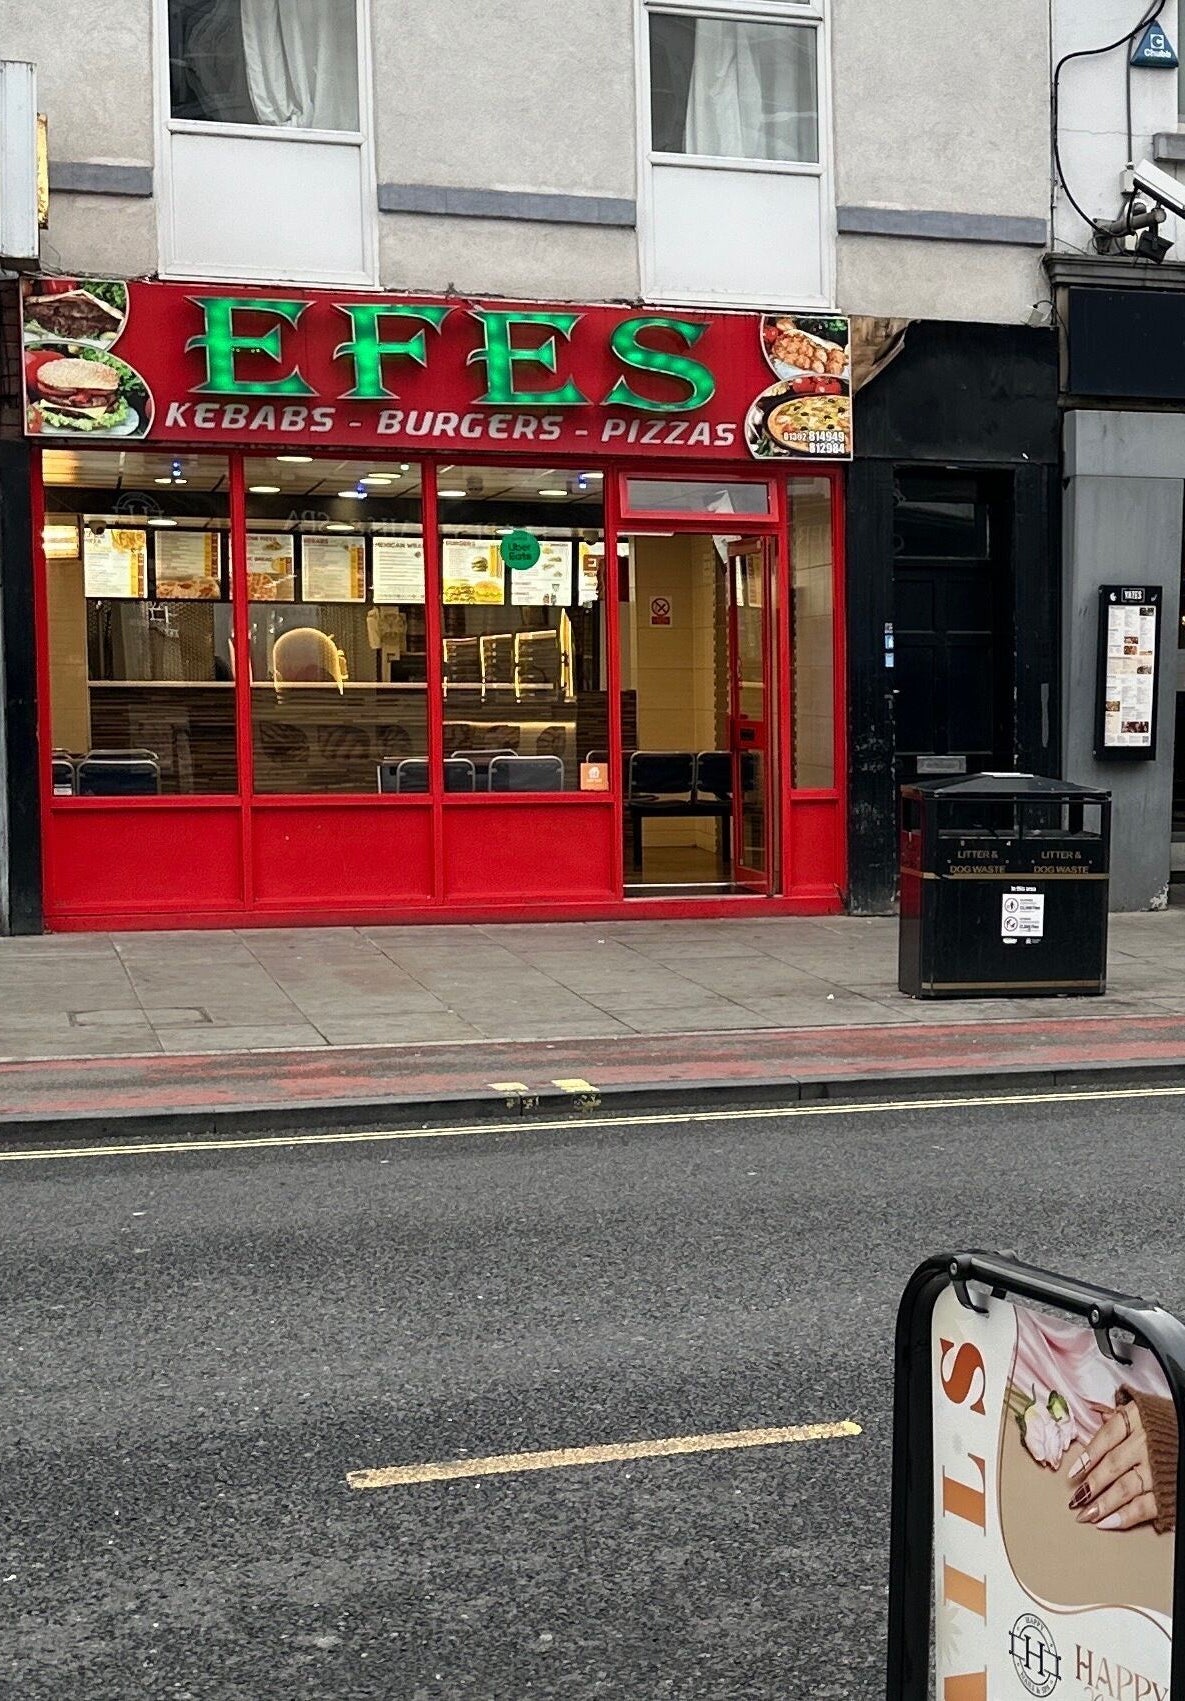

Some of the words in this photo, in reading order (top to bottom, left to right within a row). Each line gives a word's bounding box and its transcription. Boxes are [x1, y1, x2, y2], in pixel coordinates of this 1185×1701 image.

[184, 295, 716, 413] EFES
[165, 402, 336, 433] KEBABS
[376, 409, 564, 441] BURGERS
[600, 418, 738, 447] PIZZAS
[508, 542, 531, 551] Uber
[508, 551, 532, 561] Eats
[957, 850, 990, 859] LITTER
[990, 850, 999, 859] &
[1041, 850, 1073, 859] LITTER
[1073, 850, 1082, 859] &
[950, 865, 972, 874] DOG
[972, 865, 1006, 873] WASTE
[1033, 865, 1056, 874] DOG
[1055, 865, 1089, 874] WASTE
[940, 1337, 988, 1701] ILS
